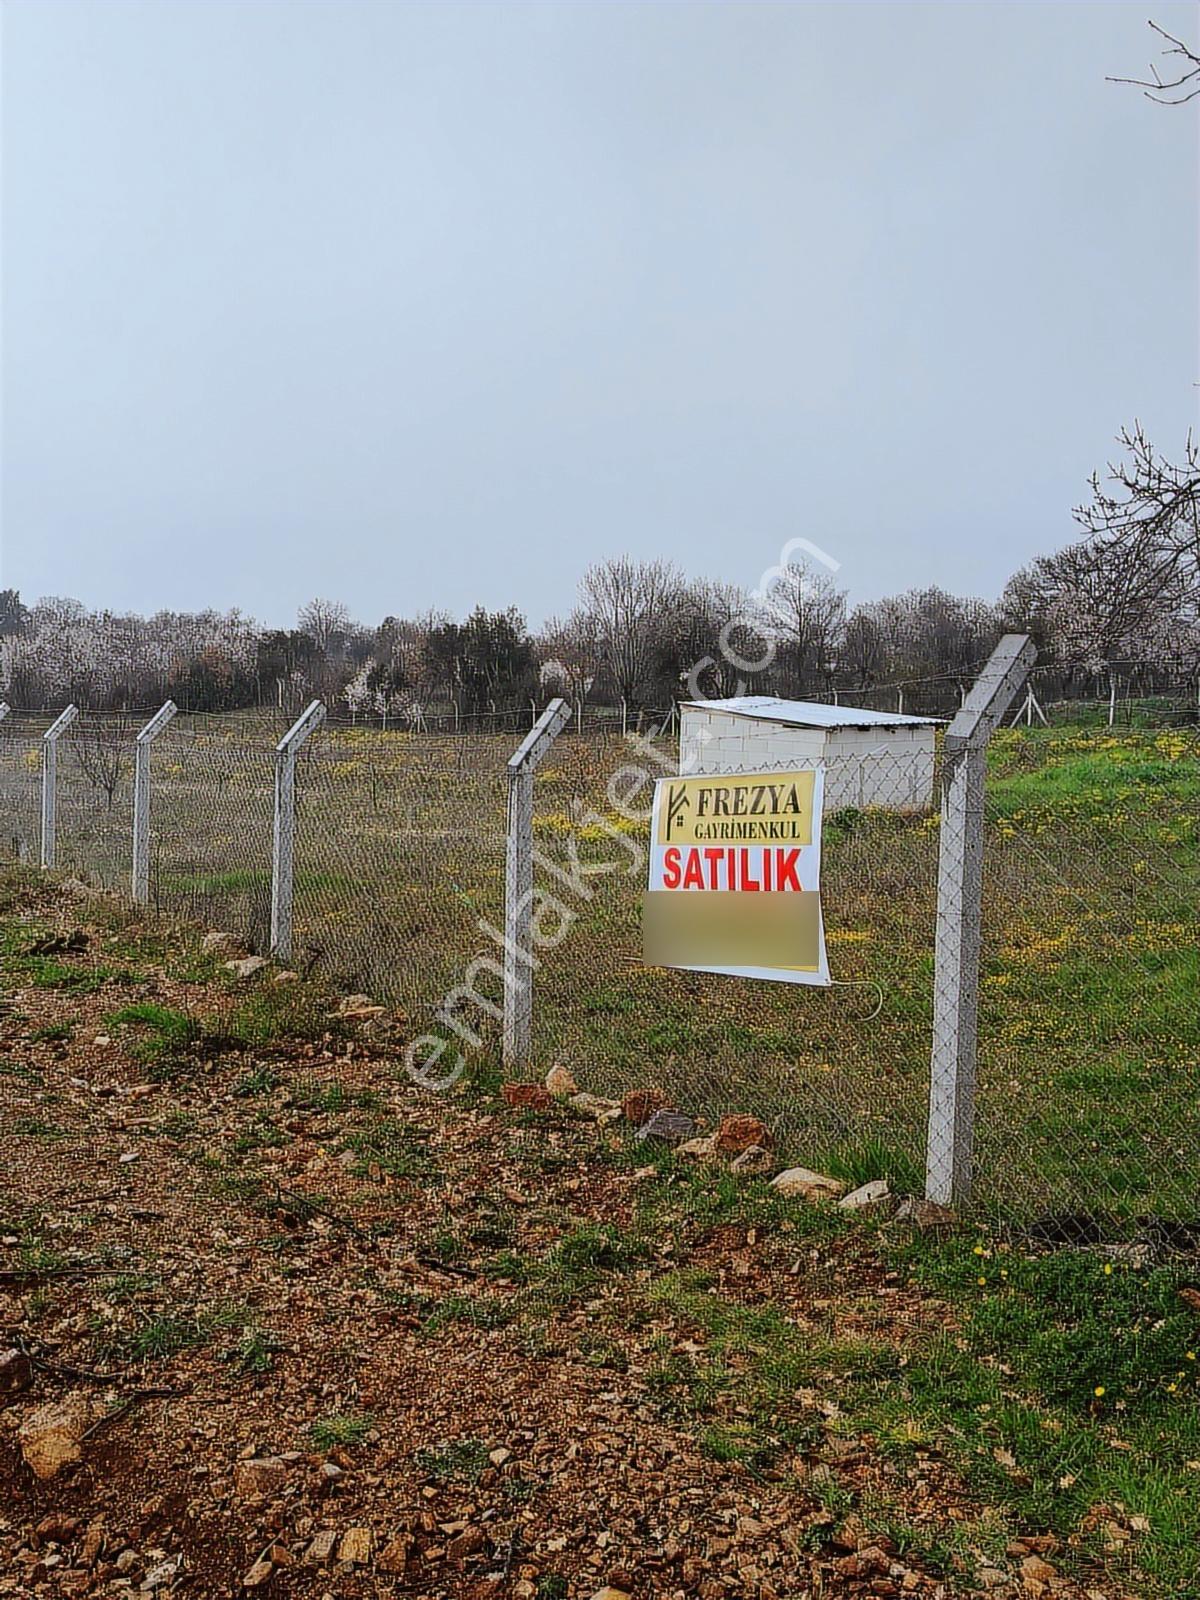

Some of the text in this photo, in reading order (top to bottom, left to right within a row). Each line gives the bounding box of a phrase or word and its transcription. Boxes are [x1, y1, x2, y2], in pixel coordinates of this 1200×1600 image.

[697, 784, 801, 816] FREZYA
[694, 819, 800, 839] GAYRİMENKUL
[663, 847, 802, 892] SATILIK
